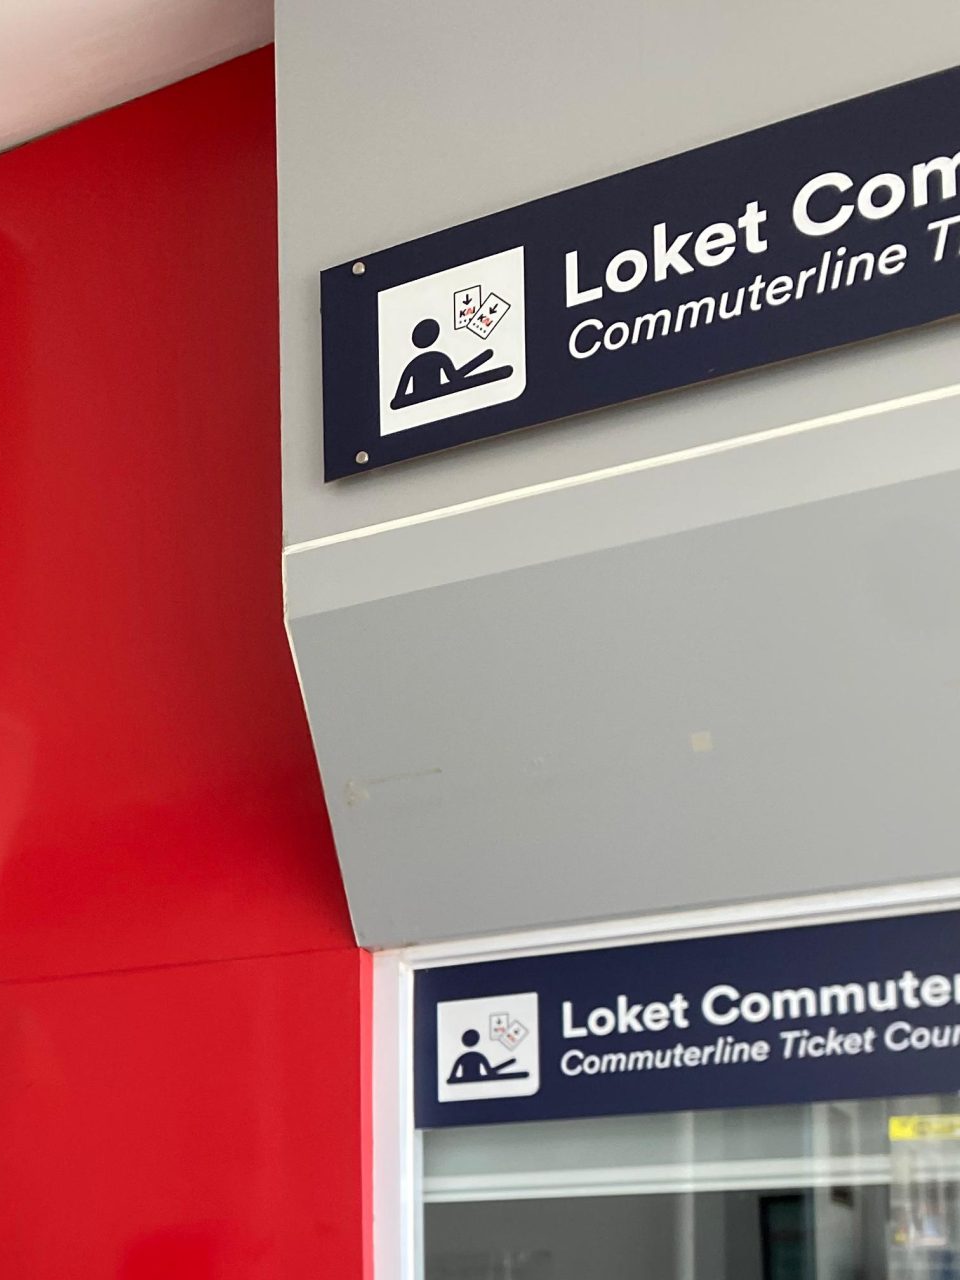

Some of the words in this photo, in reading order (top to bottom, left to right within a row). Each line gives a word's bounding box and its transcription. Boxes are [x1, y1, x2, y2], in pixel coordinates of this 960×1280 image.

[565, 200, 768, 308] Loket
[568, 243, 907, 359] Commuterline
[560, 1038, 771, 1076] Commuterline
[779, 1026, 877, 1059] Ticket
[562, 993, 689, 1039] Loket
